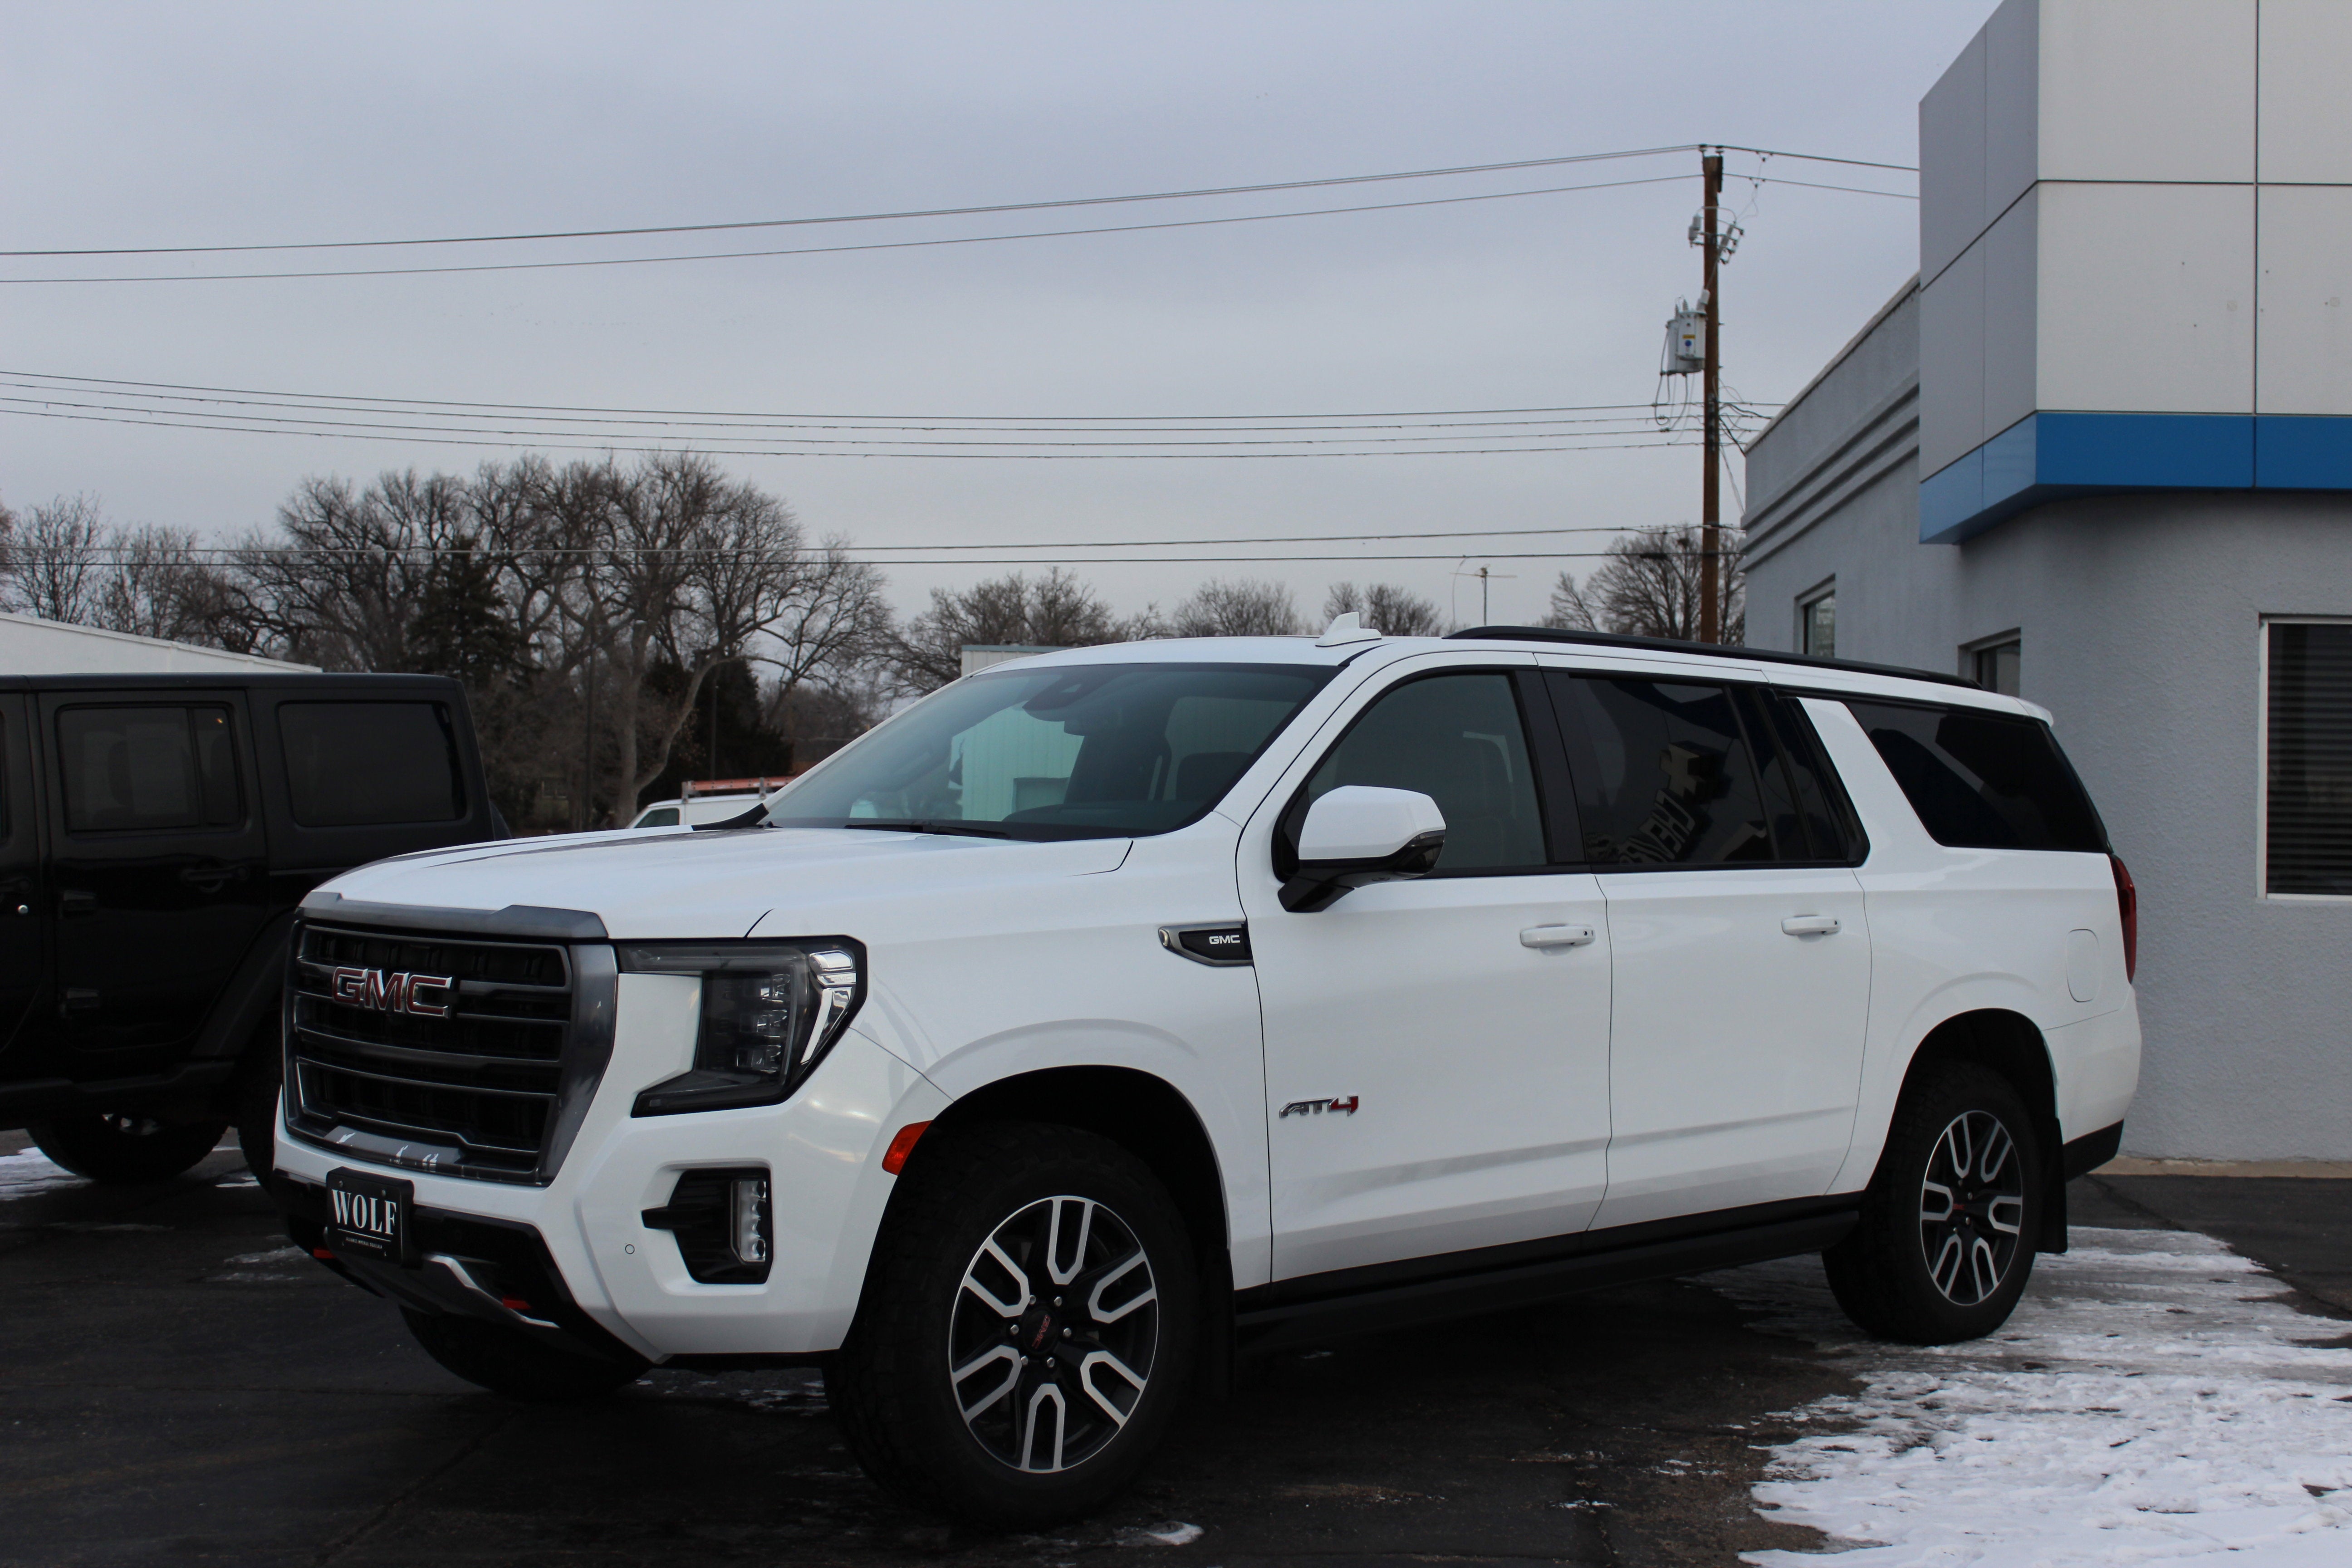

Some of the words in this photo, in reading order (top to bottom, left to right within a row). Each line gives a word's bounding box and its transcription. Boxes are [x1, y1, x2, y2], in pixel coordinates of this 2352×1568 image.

[1209, 934, 1240, 944] GMC
[332, 966, 452, 1019] GMC
[1279, 1095, 1359, 1119] AT4
[332, 1189, 397, 1235] WOLF
[1032, 1315, 1051, 1349] GMC
